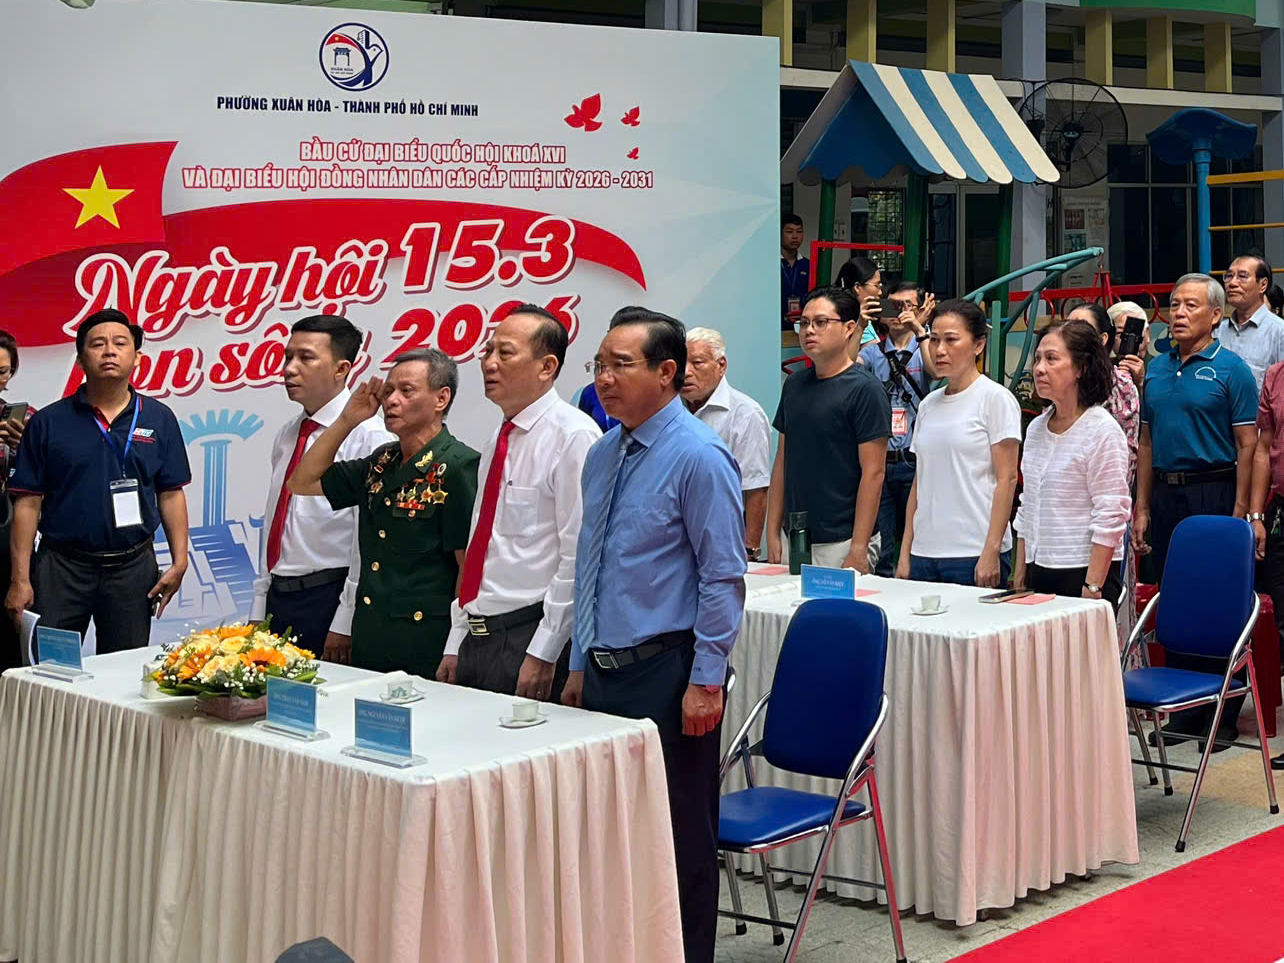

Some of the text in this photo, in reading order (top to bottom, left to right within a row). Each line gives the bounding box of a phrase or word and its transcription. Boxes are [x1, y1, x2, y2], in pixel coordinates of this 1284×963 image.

[217, 95, 268, 111] PHƯỜNG
[271, 96, 304, 112] XUÂN
[307, 97, 331, 112] HÒA
[343, 98, 380, 114] THÀNH
[384, 98, 406, 115] PHỐ
[409, 99, 425, 115] HỒ
[428, 100, 448, 116] CHÍ
[451, 104, 479, 117] MINH
[300, 136, 566, 165] BẦU CỬ ĐẠI BIỂU QUỐC HỘI KHOÁ XVI
[182, 165, 208, 189] VÀ
[210, 168, 241, 192] ĐẠI
[244, 162, 284, 189] BIỂU
[286, 165, 317, 192] HỘI
[319, 163, 364, 188] ĐỒNG
[367, 166, 409, 188] NHÂN
[412, 166, 443, 188] DÂN
[445, 167, 476, 188] CÁC
[478, 165, 508, 189] CẤP
[510, 167, 553, 191] NHIỆM
[555, 167, 574, 188] KỲ
[576, 170, 611, 189] 2026
[621, 170, 653, 189] 2031
[63, 217, 575, 334] Ngày hội 15.3
[62, 346, 197, 398] on
